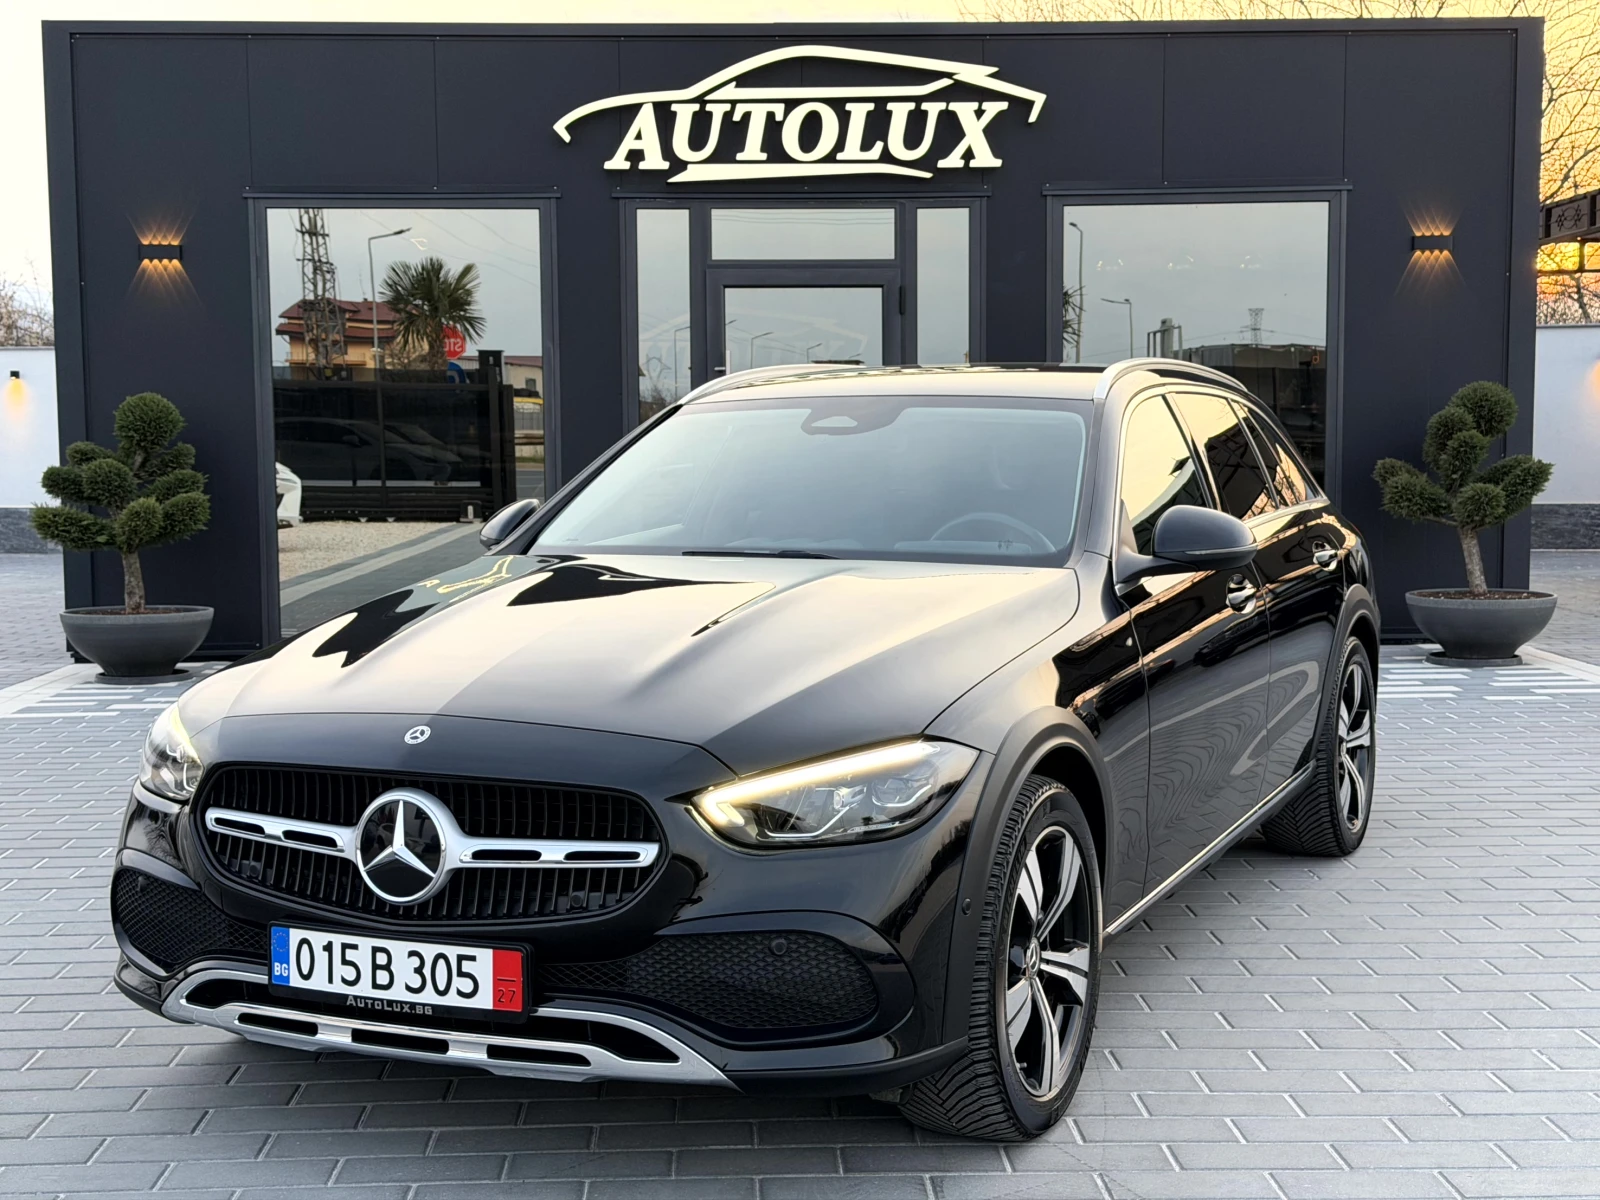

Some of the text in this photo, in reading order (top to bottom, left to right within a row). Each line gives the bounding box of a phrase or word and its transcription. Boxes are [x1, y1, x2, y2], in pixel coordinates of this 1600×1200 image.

[604, 101, 1009, 170] AUTOLUX
[274, 962, 289, 977] BG
[295, 937, 480, 1000] 015 B 305
[497, 988, 516, 1004] 27
